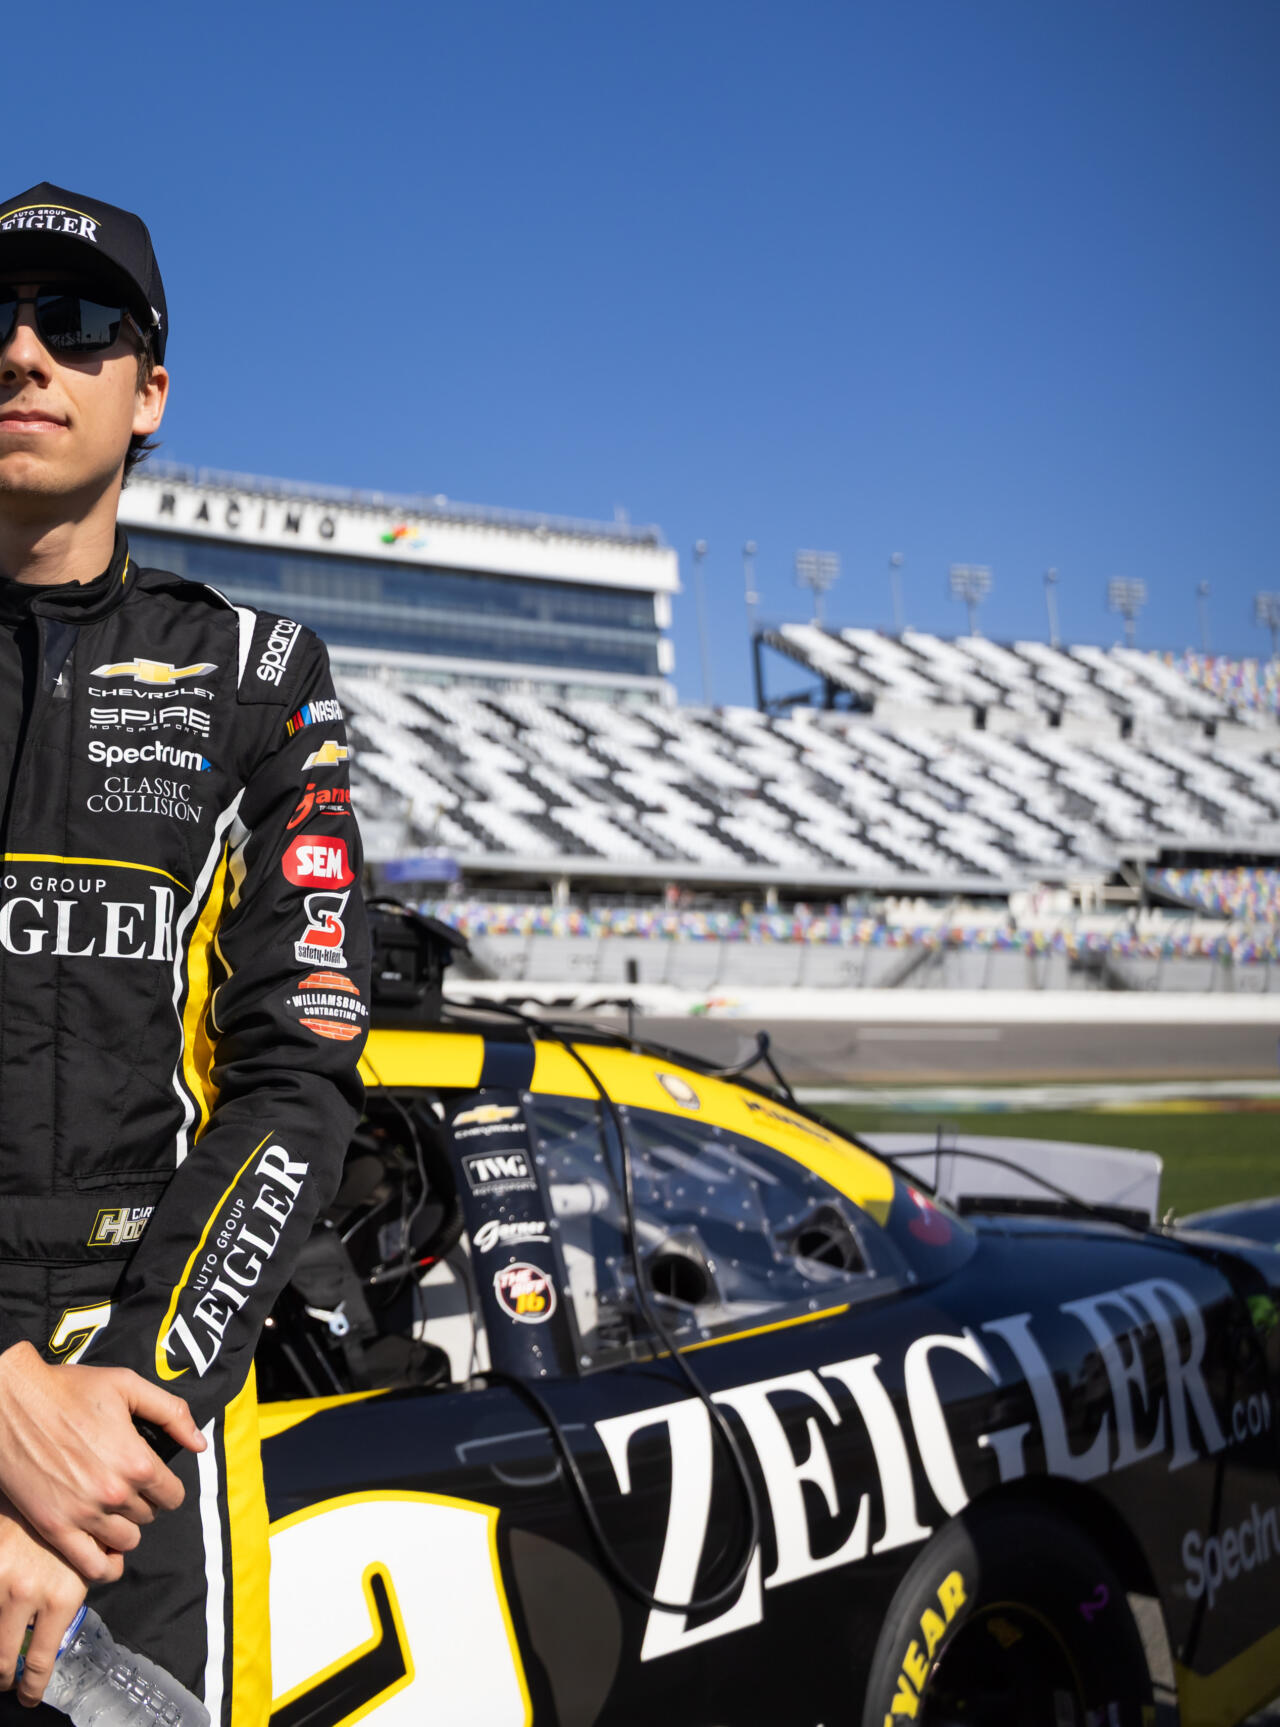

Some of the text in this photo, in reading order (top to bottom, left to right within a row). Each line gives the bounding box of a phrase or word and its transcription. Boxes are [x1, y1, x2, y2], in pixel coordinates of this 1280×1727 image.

[13, 210, 35, 218] AUTO
[158, 493, 337, 539] RACING
[256, 618, 302, 686] sparco
[88, 687, 215, 701] CHEVROLET
[90, 706, 210, 732] SPIRE
[88, 740, 203, 772] Spectrum
[104, 776, 191, 802] CLASSIC
[86, 794, 203, 824] COLLISION
[296, 845, 344, 880] SEM
[30, 876, 107, 893] GROUP
[292, 993, 366, 1016] WILLIAMSBURG
[304, 1007, 357, 1021] CONTRACTING
[193, 1198, 245, 1291] AUTO GROUP
[160, 1145, 309, 1377] ZEIGLER
